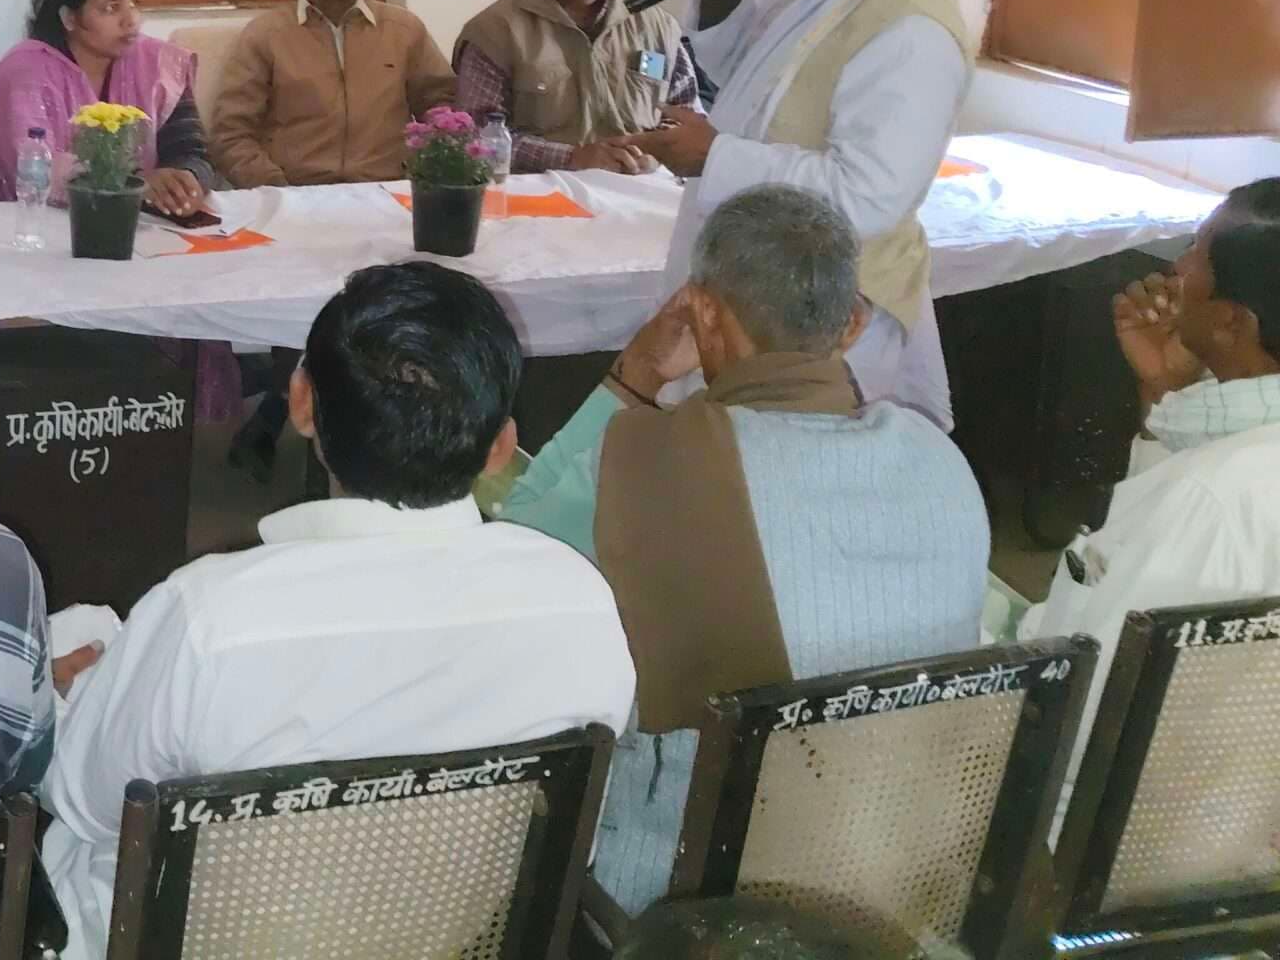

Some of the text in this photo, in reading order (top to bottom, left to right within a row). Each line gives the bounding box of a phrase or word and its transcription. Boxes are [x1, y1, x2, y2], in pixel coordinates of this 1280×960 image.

[70, 445, 110, 483] (5)
[823, 685, 873, 722] कृषि
[272, 777, 338, 817] कृषि
